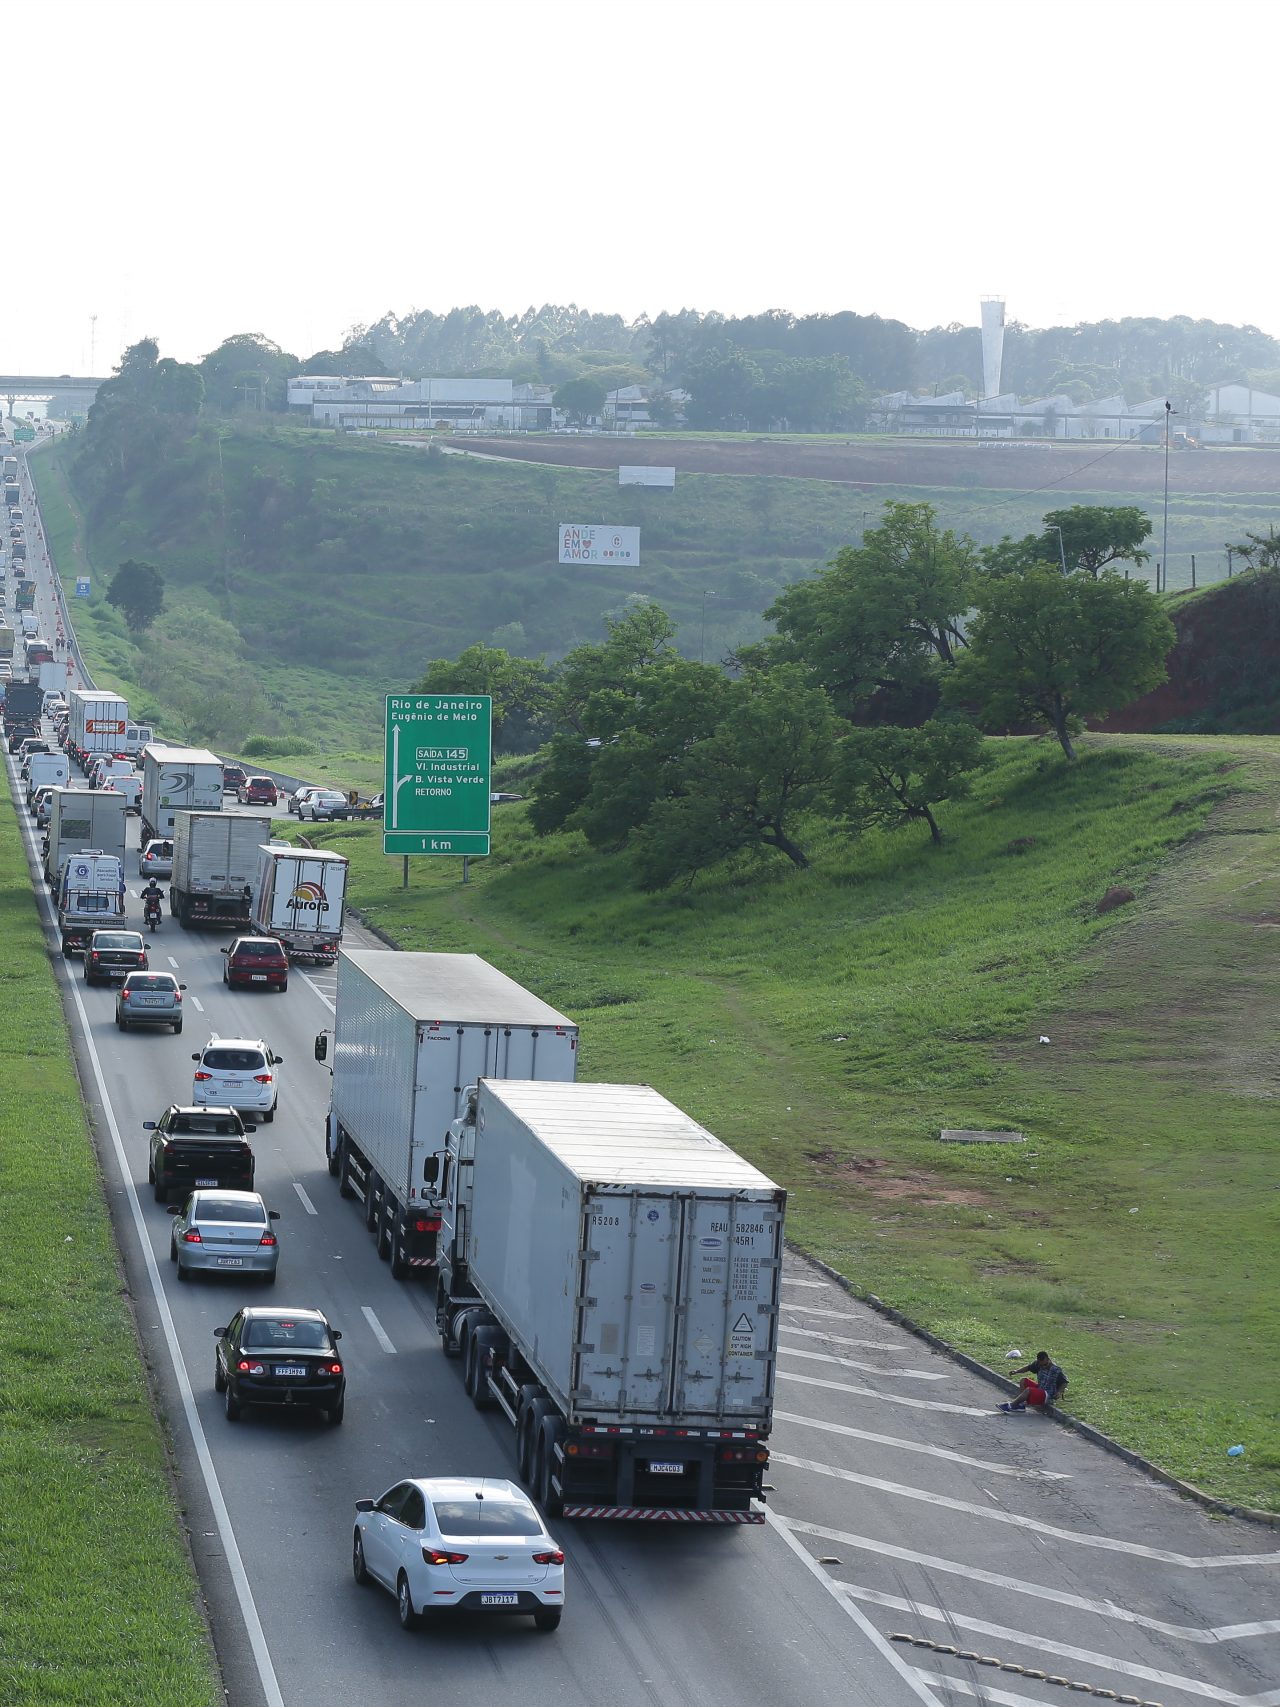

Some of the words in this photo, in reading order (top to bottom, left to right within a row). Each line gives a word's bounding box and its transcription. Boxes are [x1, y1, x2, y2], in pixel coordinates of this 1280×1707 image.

[564, 529, 595, 540] ANDE
[564, 539, 580, 549] EM
[563, 549, 598, 559] AMOR
[391, 700, 411, 709] Rio
[415, 700, 430, 709] de
[434, 700, 483, 710] Janeiro
[391, 712, 433, 723] Eugênio
[437, 713, 449, 721] de
[452, 713, 478, 721] Melo
[446, 749, 466, 759] 145
[431, 762, 480, 771] Industrial
[415, 775, 424, 783] B.
[427, 775, 453, 783] Vista
[456, 775, 484, 784] Verde
[415, 788, 452, 796] RETORNO
[421, 838, 426, 849] 1
[431, 839, 452, 850] km
[286, 899, 329, 911] Aurora
[710, 1222, 729, 1233] REAU
[735, 1223, 764, 1234] 582846
[735, 1236, 754, 1246] 45R1
